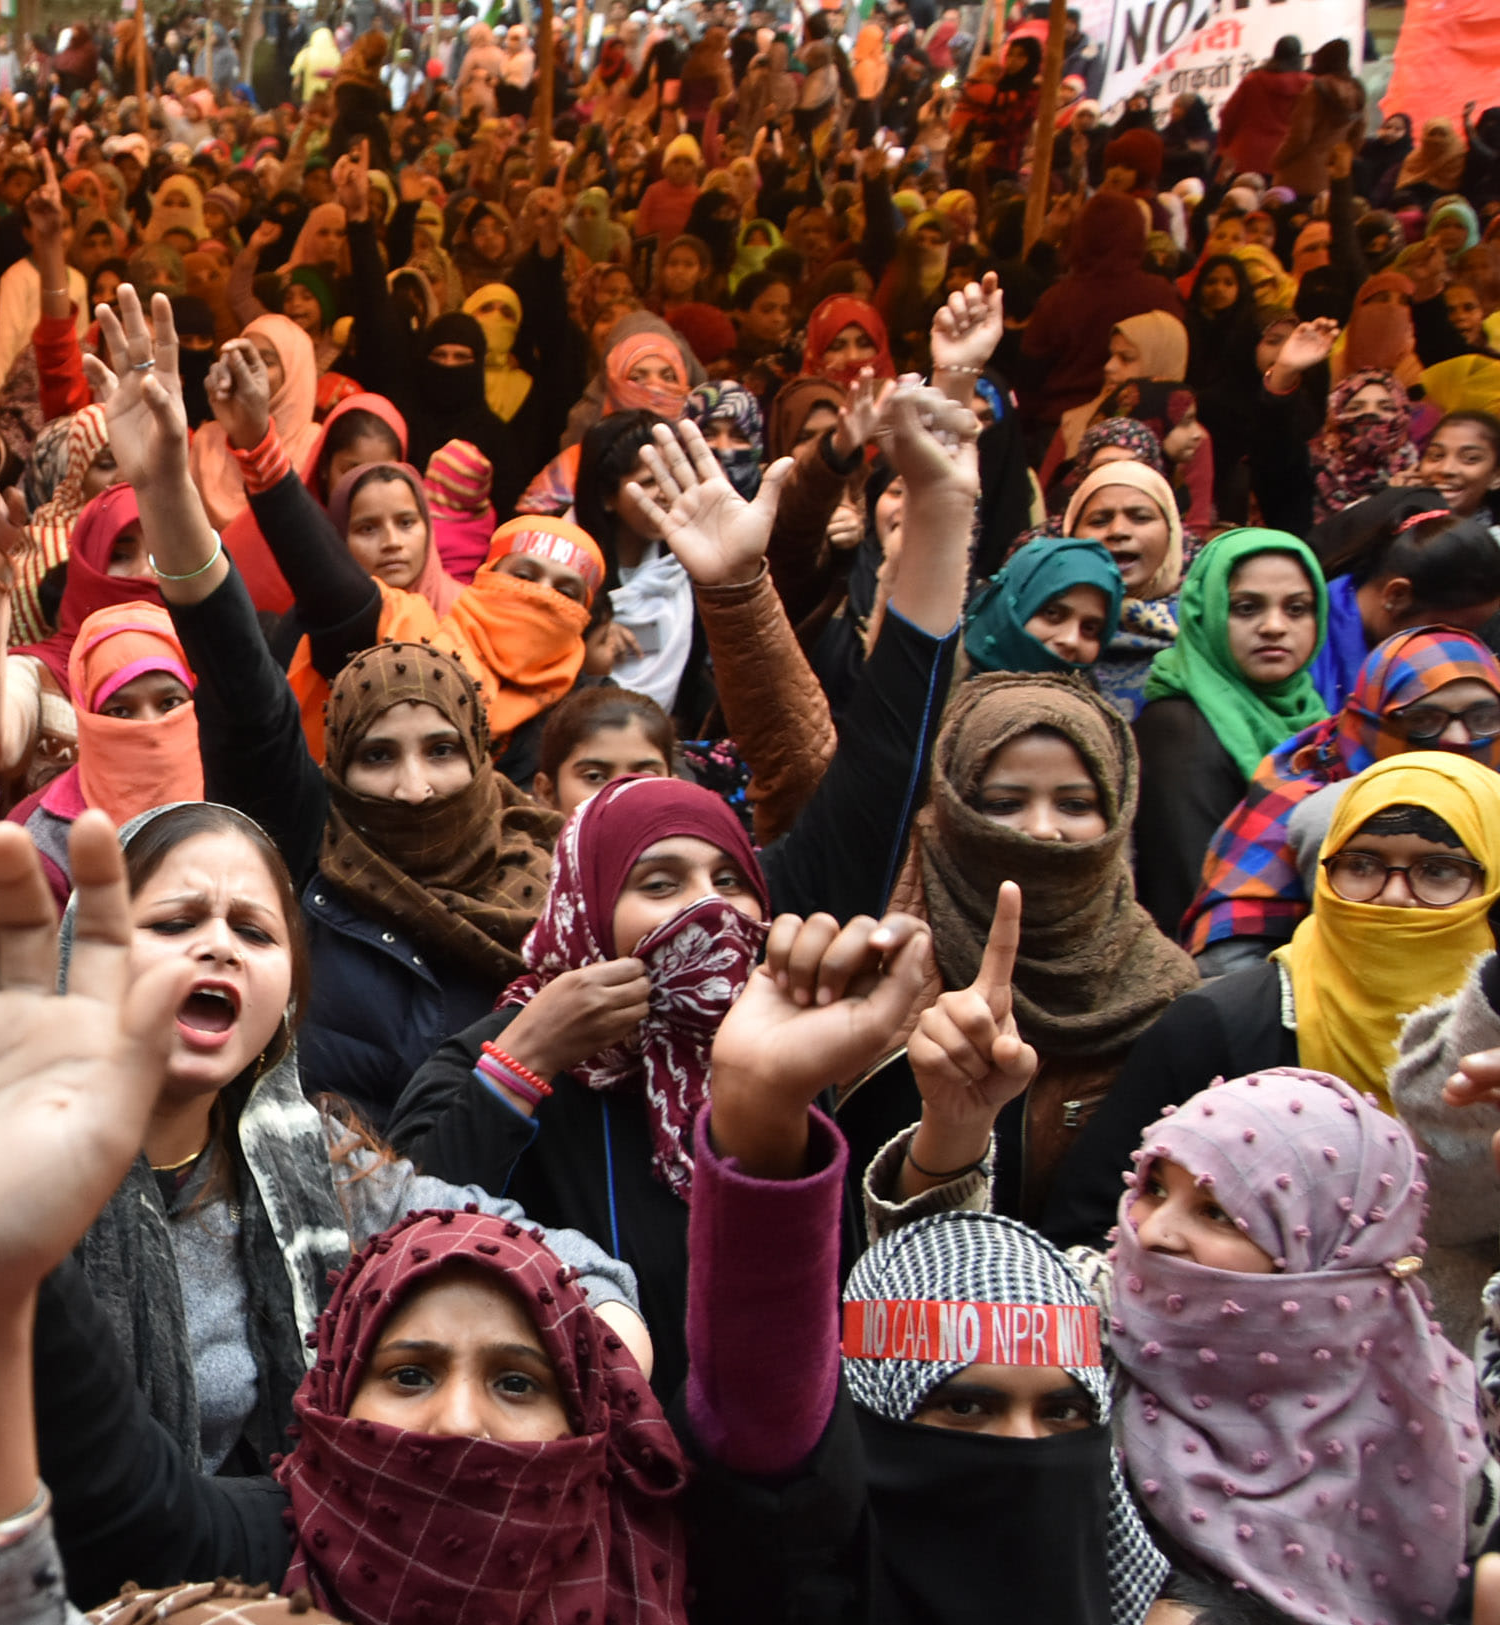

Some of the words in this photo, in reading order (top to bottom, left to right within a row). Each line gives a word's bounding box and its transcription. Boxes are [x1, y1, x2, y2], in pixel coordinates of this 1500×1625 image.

[526, 531, 555, 558] CAA
[549, 536, 576, 565] NO
[861, 1301, 888, 1356] NO
[892, 1302, 930, 1359] CAA
[938, 1303, 981, 1362] NO
[991, 1305, 1049, 1365] NPR
[1056, 1307, 1084, 1366] NO
